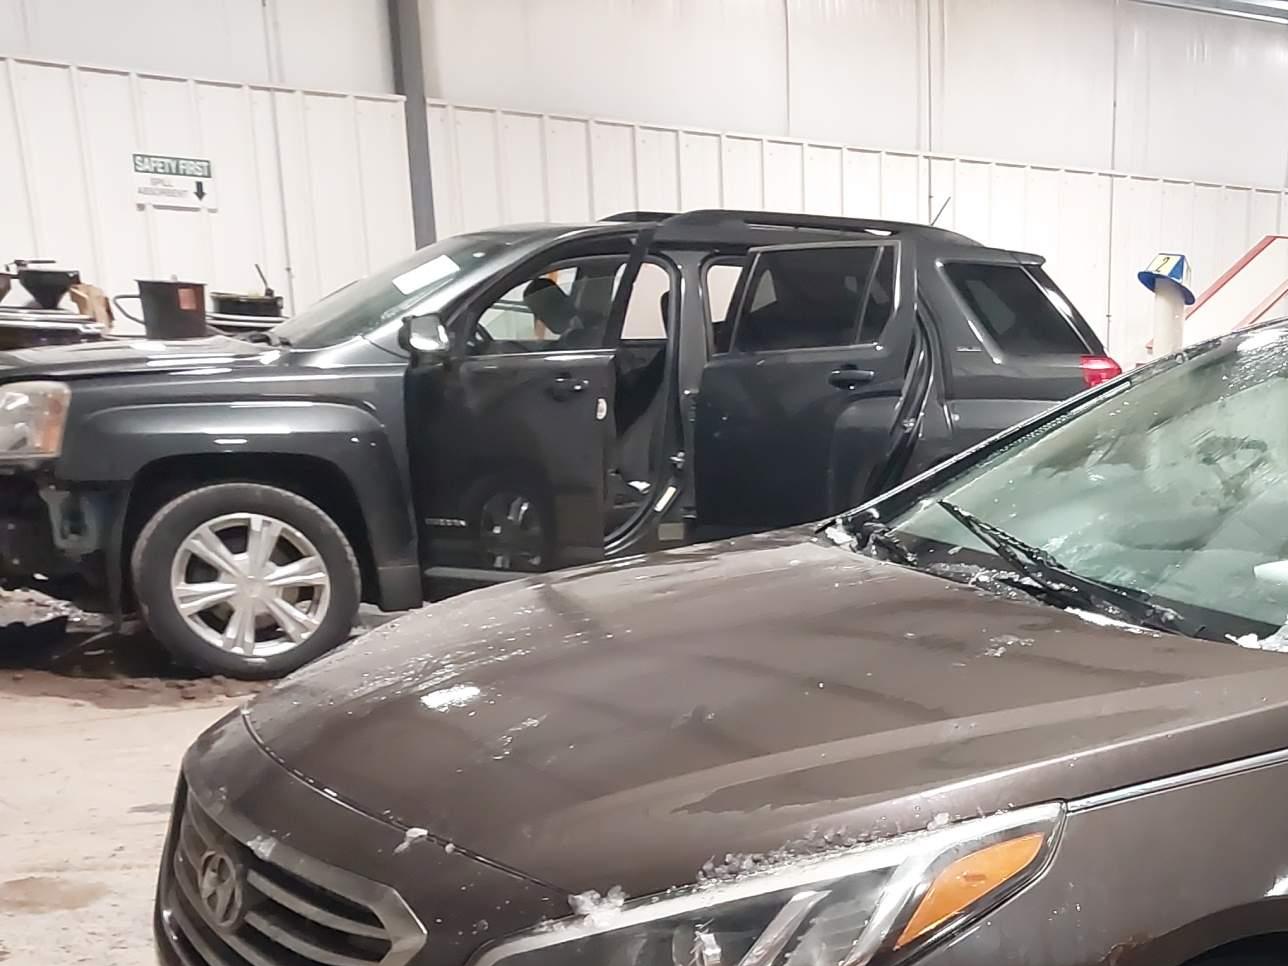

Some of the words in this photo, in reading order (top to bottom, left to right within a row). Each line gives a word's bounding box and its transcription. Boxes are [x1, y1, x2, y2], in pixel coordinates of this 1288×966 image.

[135, 155, 178, 175] SAFETY
[179, 160, 209, 177] FIRST
[1155, 256, 1170, 273] 2
